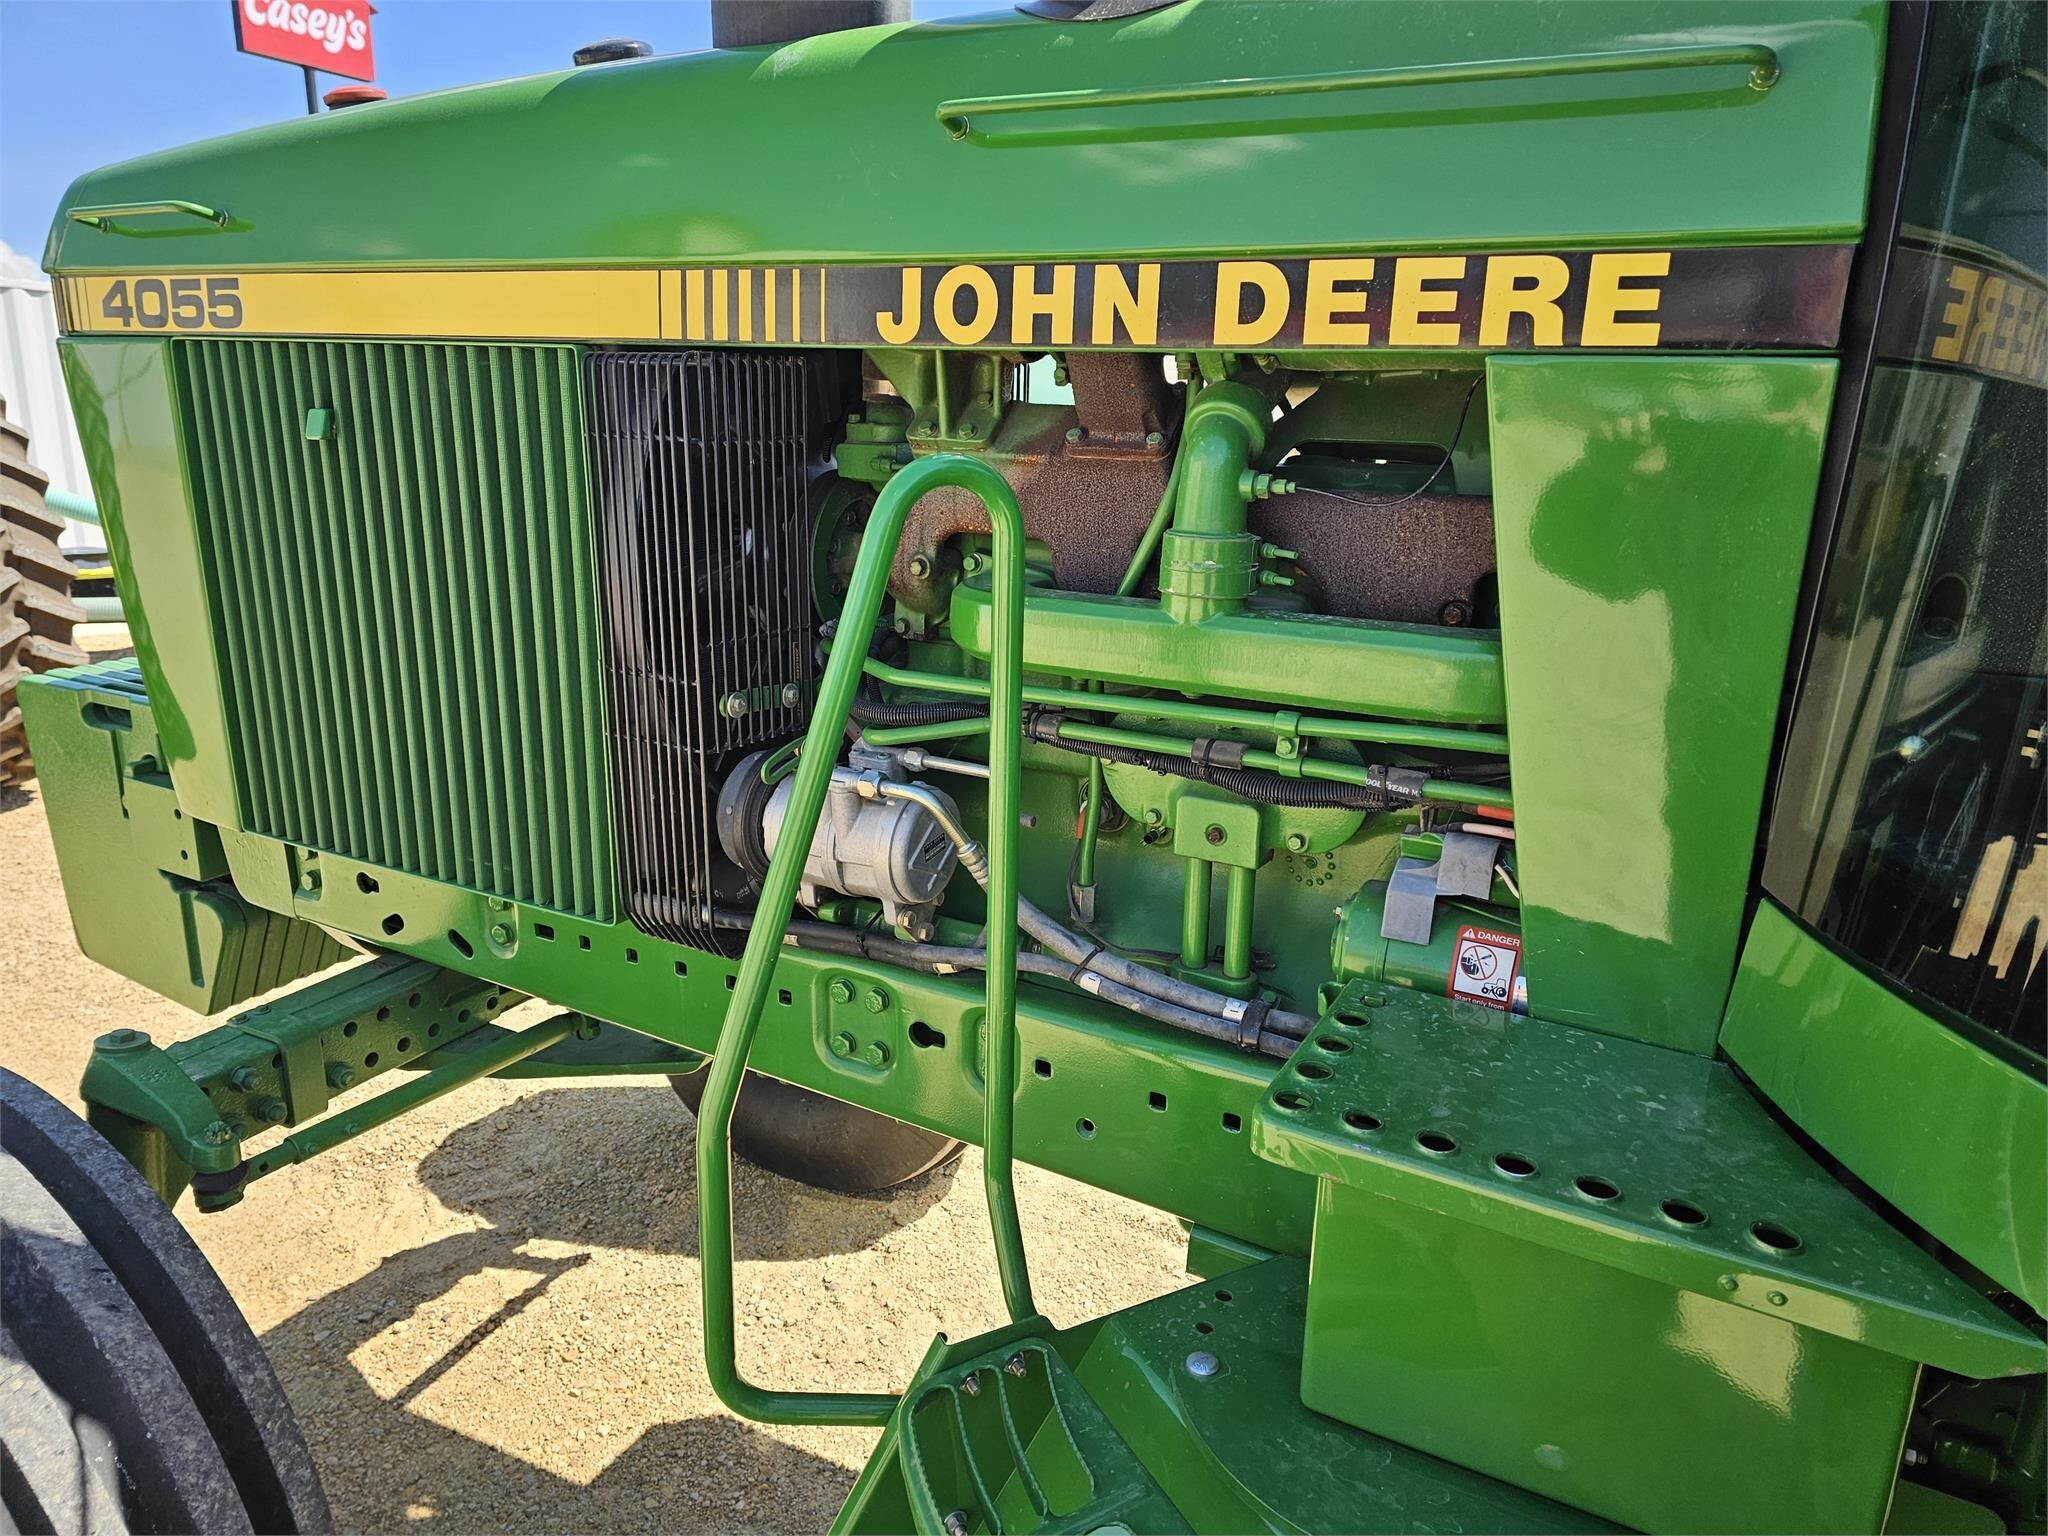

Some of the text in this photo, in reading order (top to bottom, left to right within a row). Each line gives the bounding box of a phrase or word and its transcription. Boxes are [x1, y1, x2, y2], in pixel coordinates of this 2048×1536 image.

[244, 0, 367, 54] Casey's
[102, 277, 243, 329] 4055
[876, 252, 1672, 347] JOHN DEERE
[1477, 931, 1520, 947] DANGER
[1454, 993, 1505, 1011] Start only from
